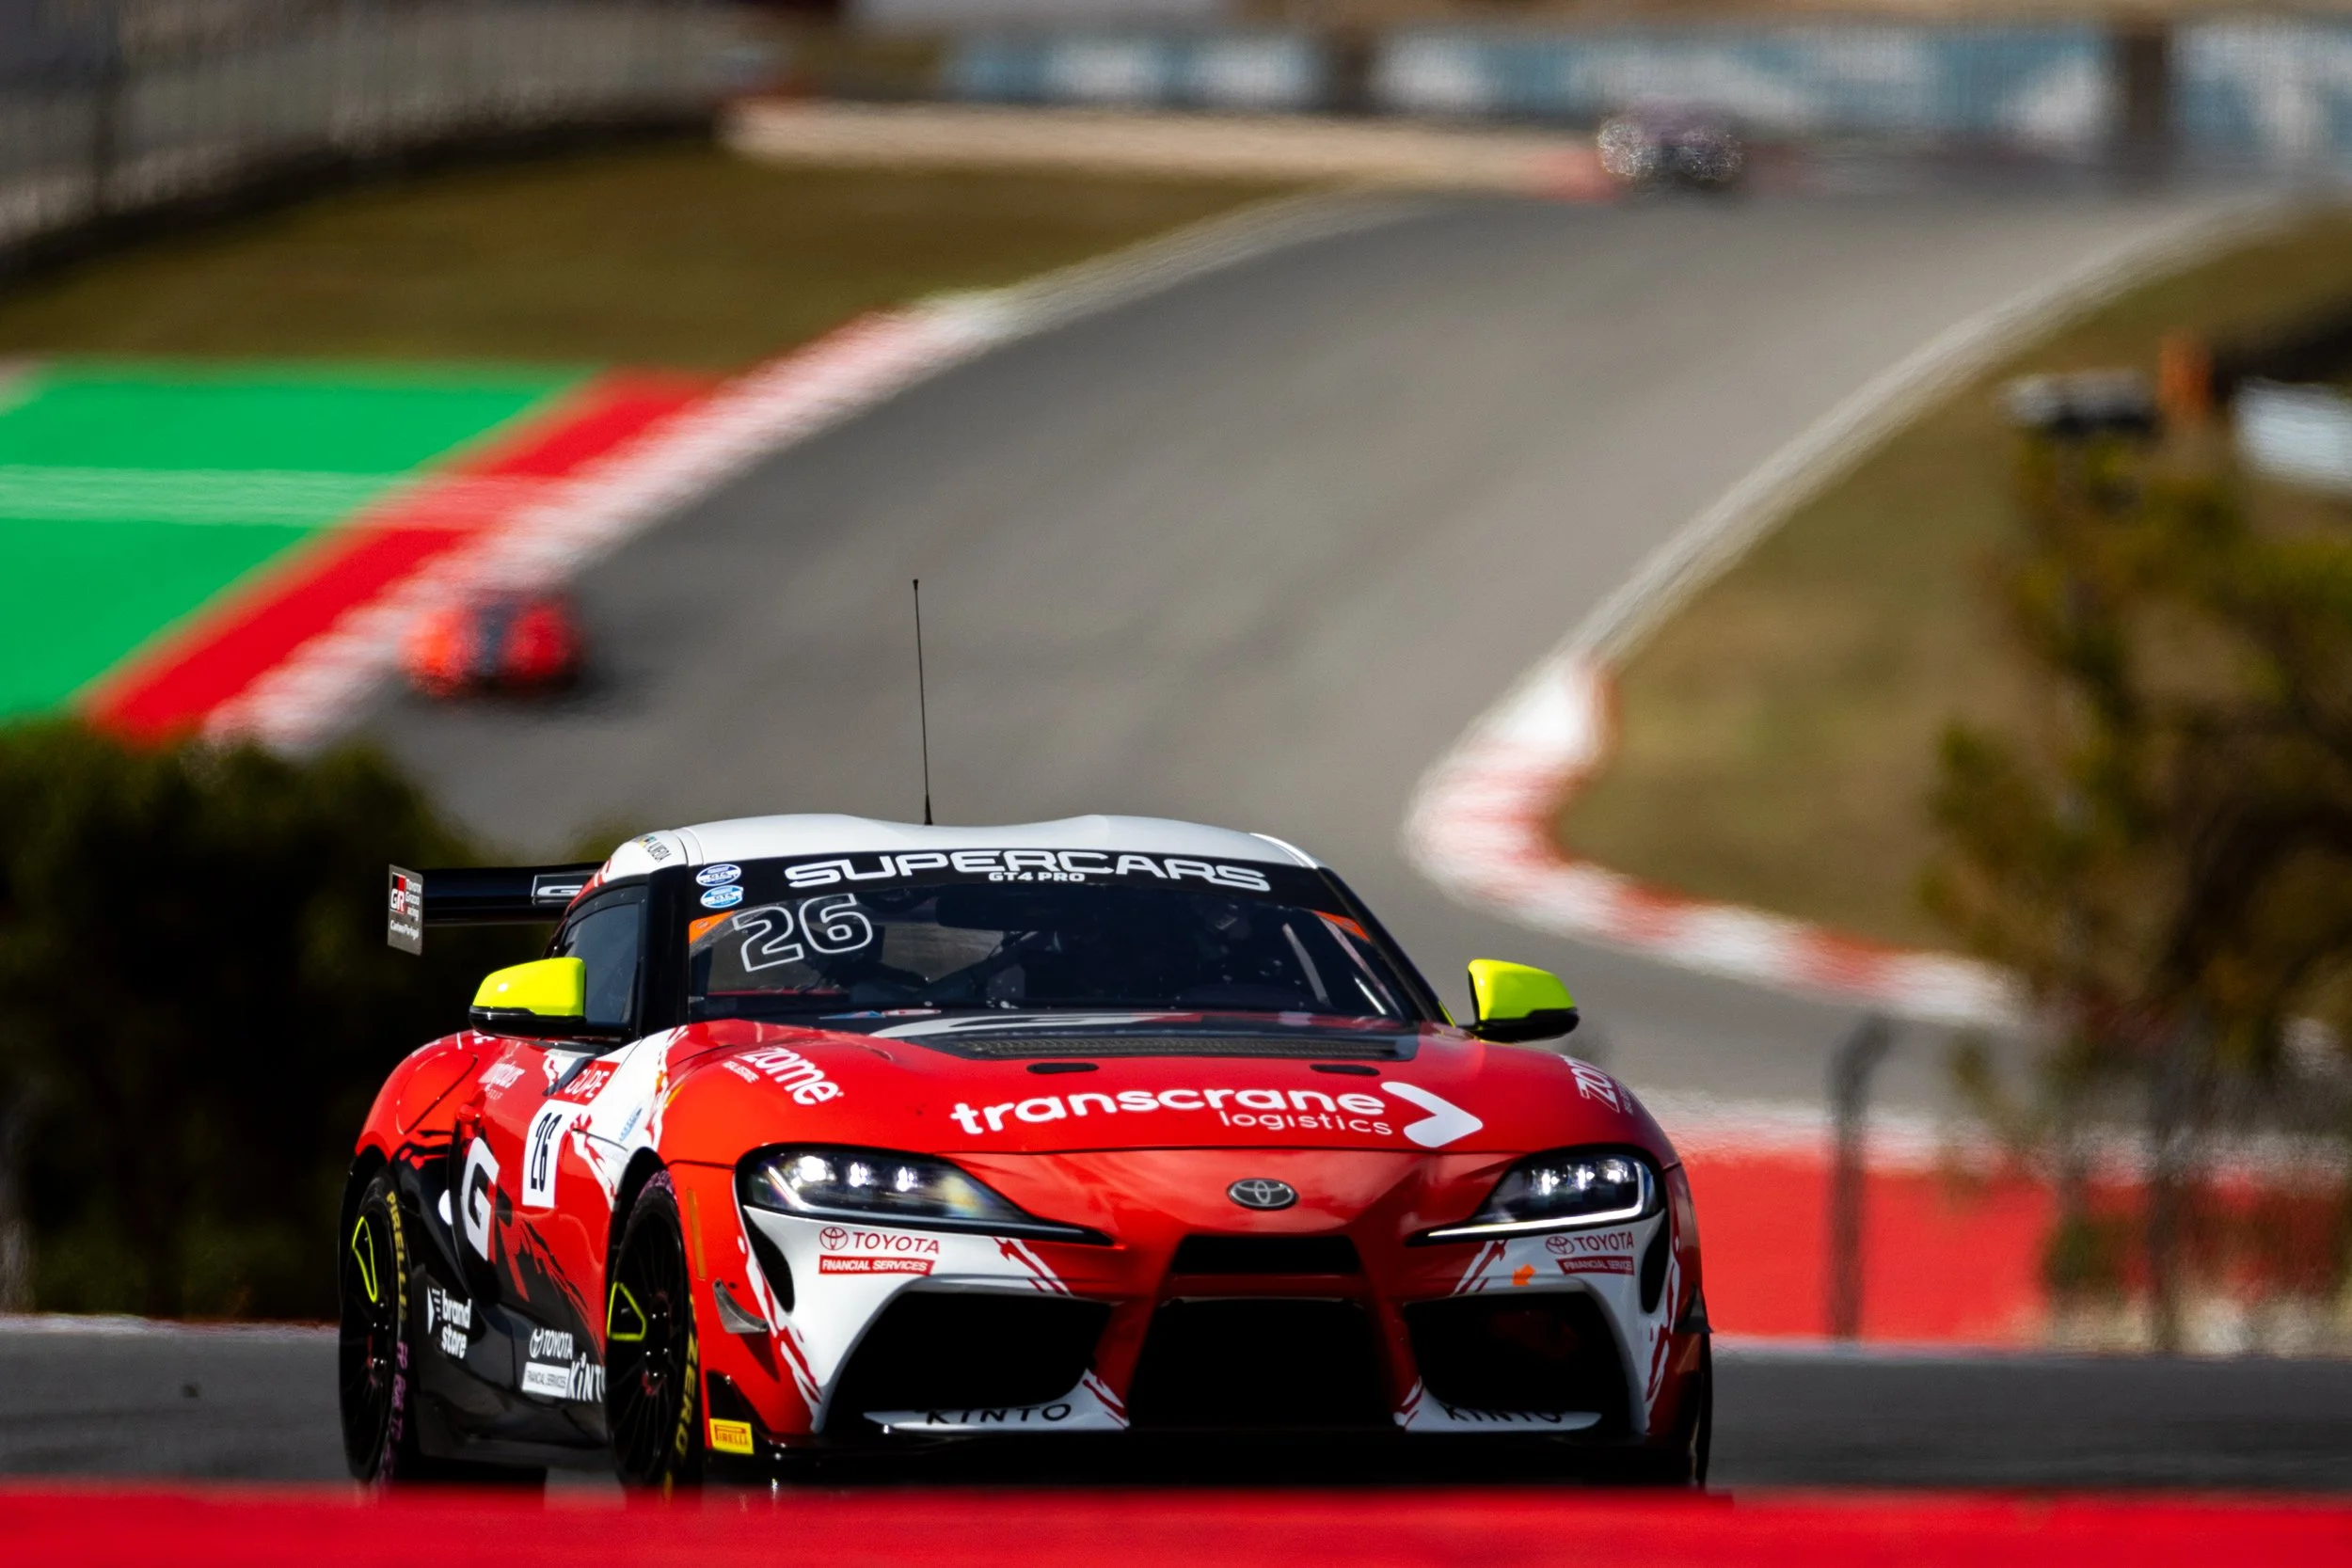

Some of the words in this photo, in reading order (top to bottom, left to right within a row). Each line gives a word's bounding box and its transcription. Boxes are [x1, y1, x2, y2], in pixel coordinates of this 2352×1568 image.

[785, 850, 1271, 892] SUPERCARS
[988, 871, 1034, 882] GT4
[1038, 872, 1086, 882] PRO
[732, 893, 873, 972] 26
[949, 1088, 1386, 1134] transcrane
[1219, 1110, 1393, 1135] logistics
[531, 1112, 563, 1193] 26
[852, 1231, 940, 1254] TOYOTA
[1573, 1230, 1634, 1252] TOYOTA
[822, 1259, 871, 1272] FINANCIAL
[872, 1260, 929, 1272] SERVICES
[442, 1288, 471, 1329] brand
[441, 1323, 467, 1359] store
[543, 1329, 573, 1360] TOYOTA
[922, 1403, 1073, 1425] KINTO
